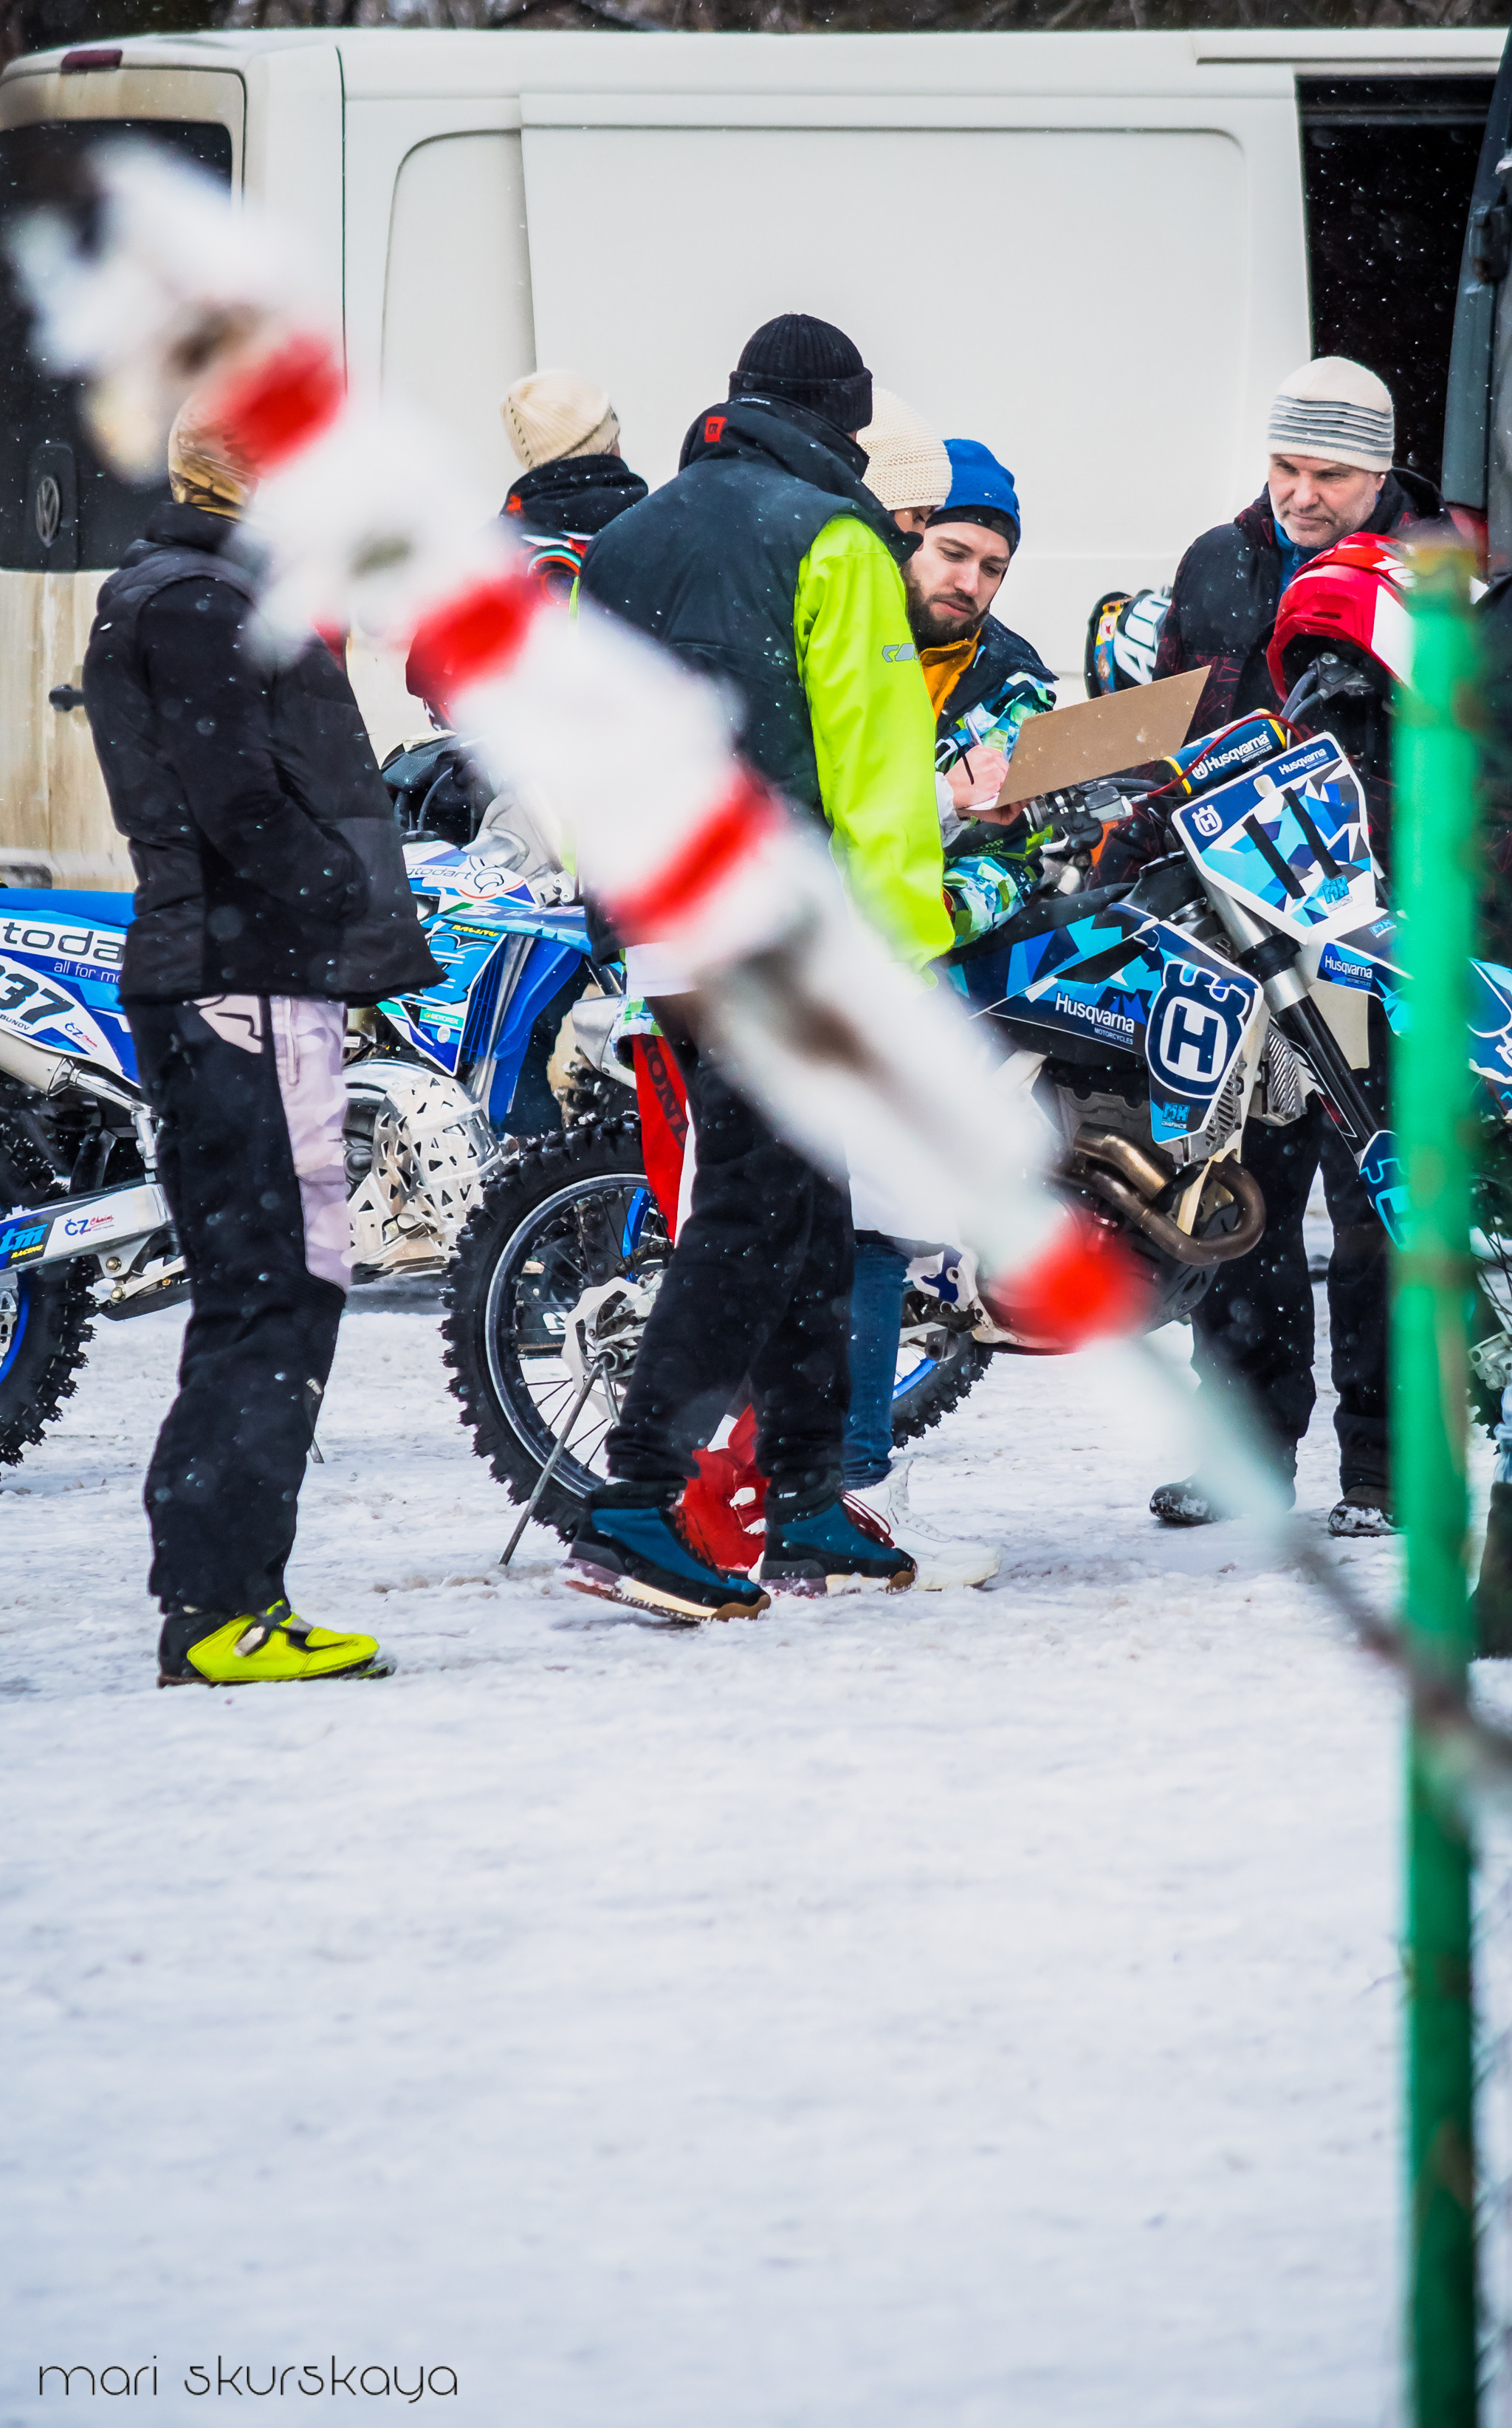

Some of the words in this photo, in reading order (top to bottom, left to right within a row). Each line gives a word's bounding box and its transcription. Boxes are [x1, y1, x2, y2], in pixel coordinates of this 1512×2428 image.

[1206, 731, 1270, 771] Husqvarna
[1242, 745, 1273, 764] MOTORCYCLES
[1279, 748, 1327, 775] Husqvarna
[3, 922, 126, 964] toda
[54, 961, 70, 973] all
[75, 964, 96, 978] for
[1324, 955, 1372, 978] Husqvarna
[0, 964, 75, 1025] 37
[0, 1013, 30, 1030] BUNOV
[1055, 992, 1135, 1034] Husqvarna
[1094, 1027, 1133, 1045] MOTORCYCLES
[10, 1244, 44, 1258] RACING
